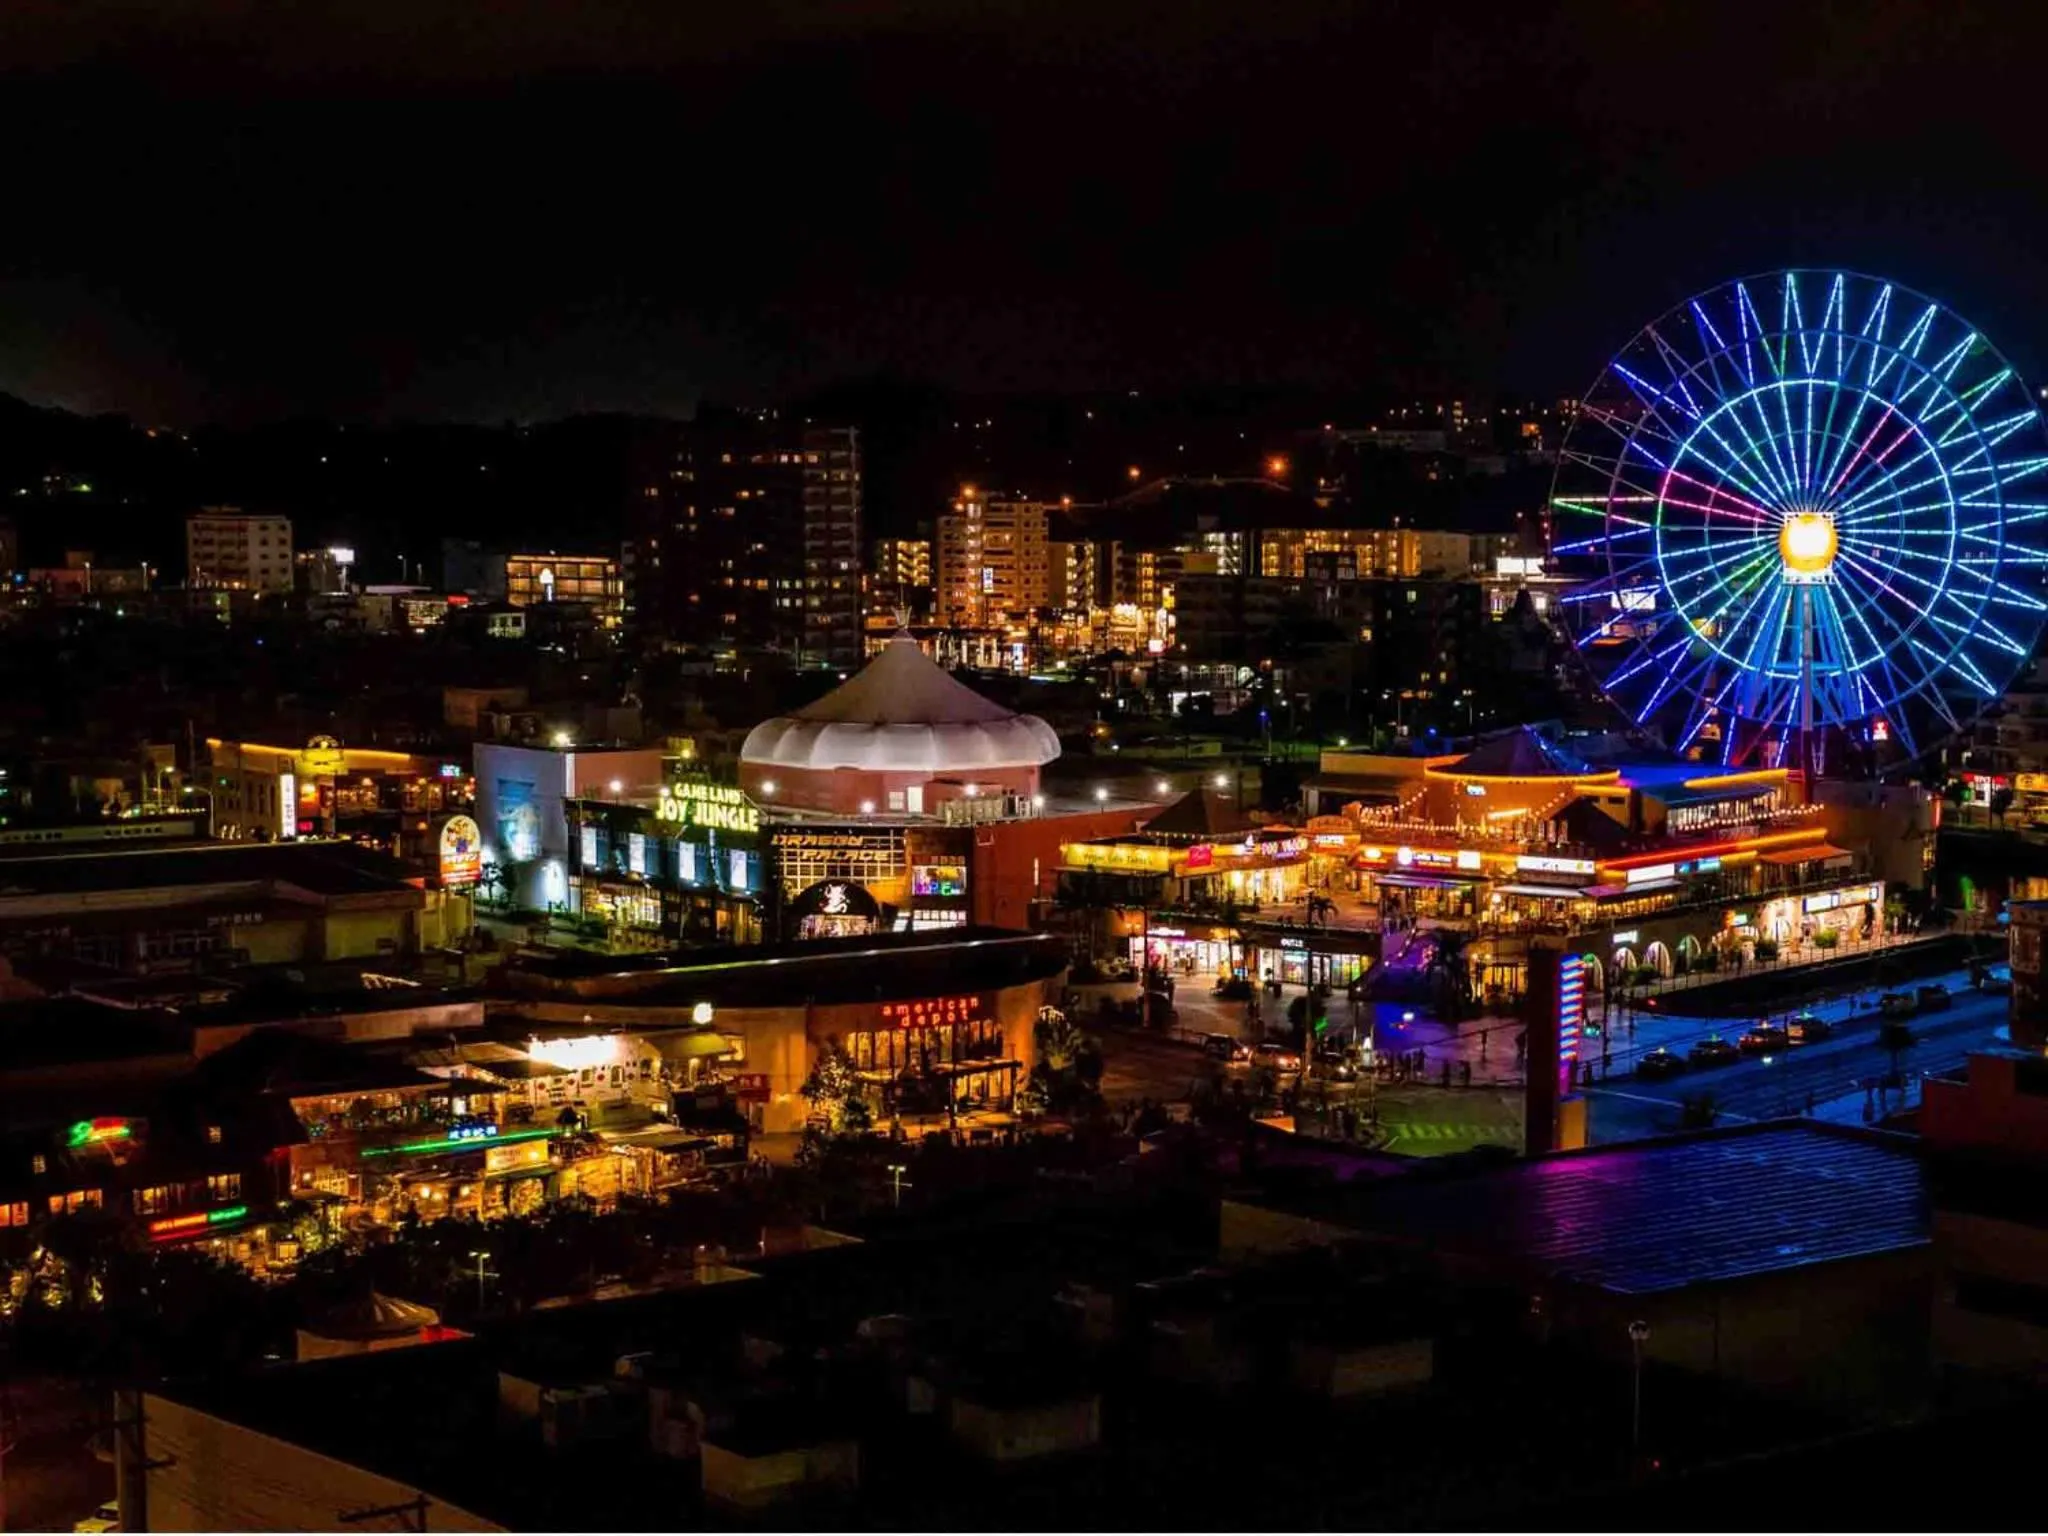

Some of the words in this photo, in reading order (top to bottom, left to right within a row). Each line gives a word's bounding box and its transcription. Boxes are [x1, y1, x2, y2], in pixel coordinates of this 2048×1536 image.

[674, 782, 707, 800] GAME
[656, 797, 689, 822] JOY
[692, 802, 760, 833] JUNGLE
[771, 834, 863, 846] DRAGON
[801, 848, 889, 861] PALACE
[882, 997, 979, 1016] american
[901, 1008, 968, 1027] depot
